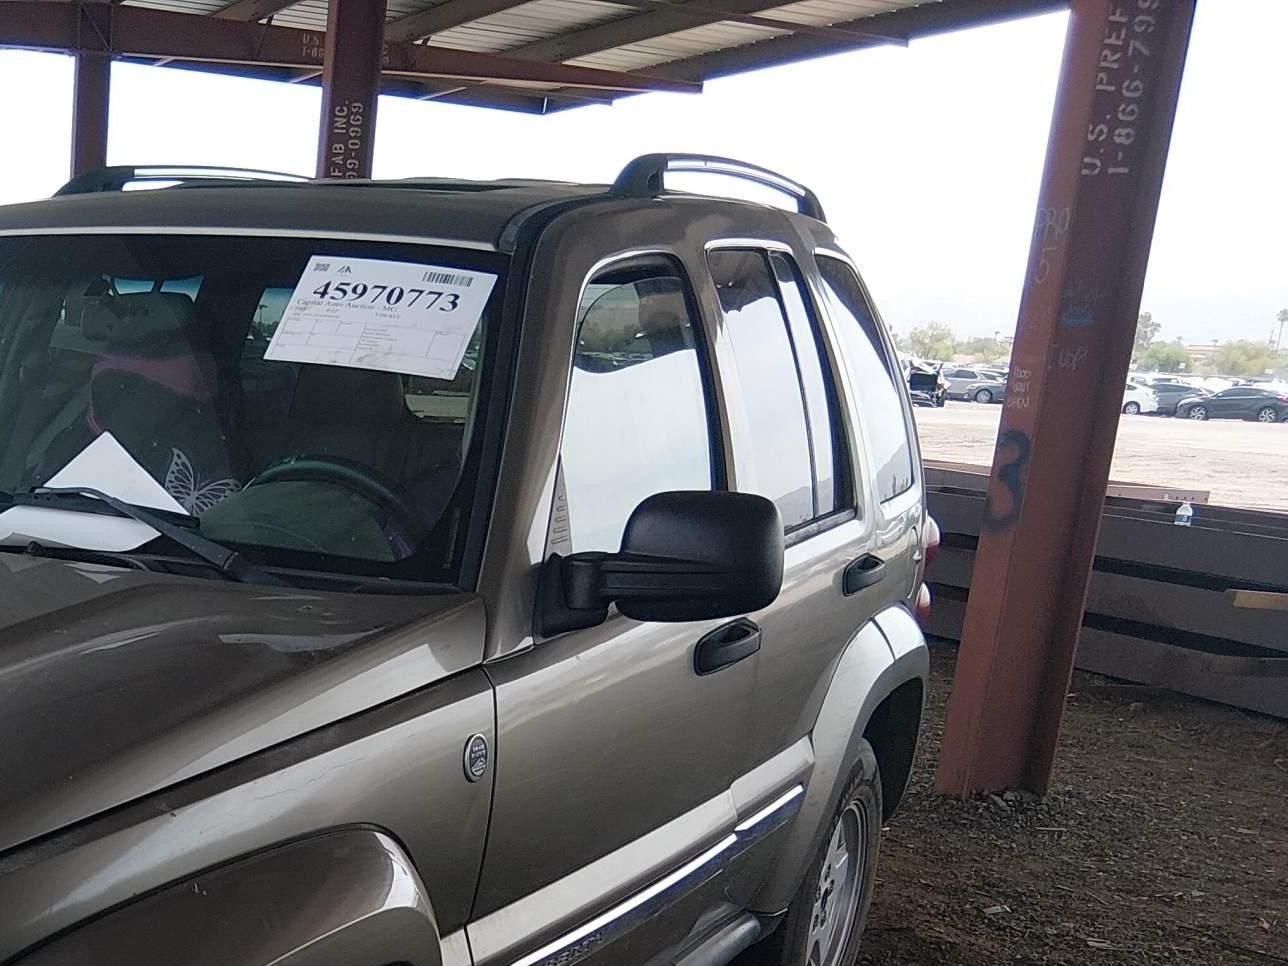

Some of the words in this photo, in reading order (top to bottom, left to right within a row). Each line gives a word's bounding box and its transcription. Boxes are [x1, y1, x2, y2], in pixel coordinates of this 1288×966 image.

[333, 100, 350, 134] INC.
[1080, 113, 1112, 176] U.S.
[313, 280, 461, 311] 45970773
[346, 302, 376, 310] Auction
[987, 430, 1030, 530] 3
